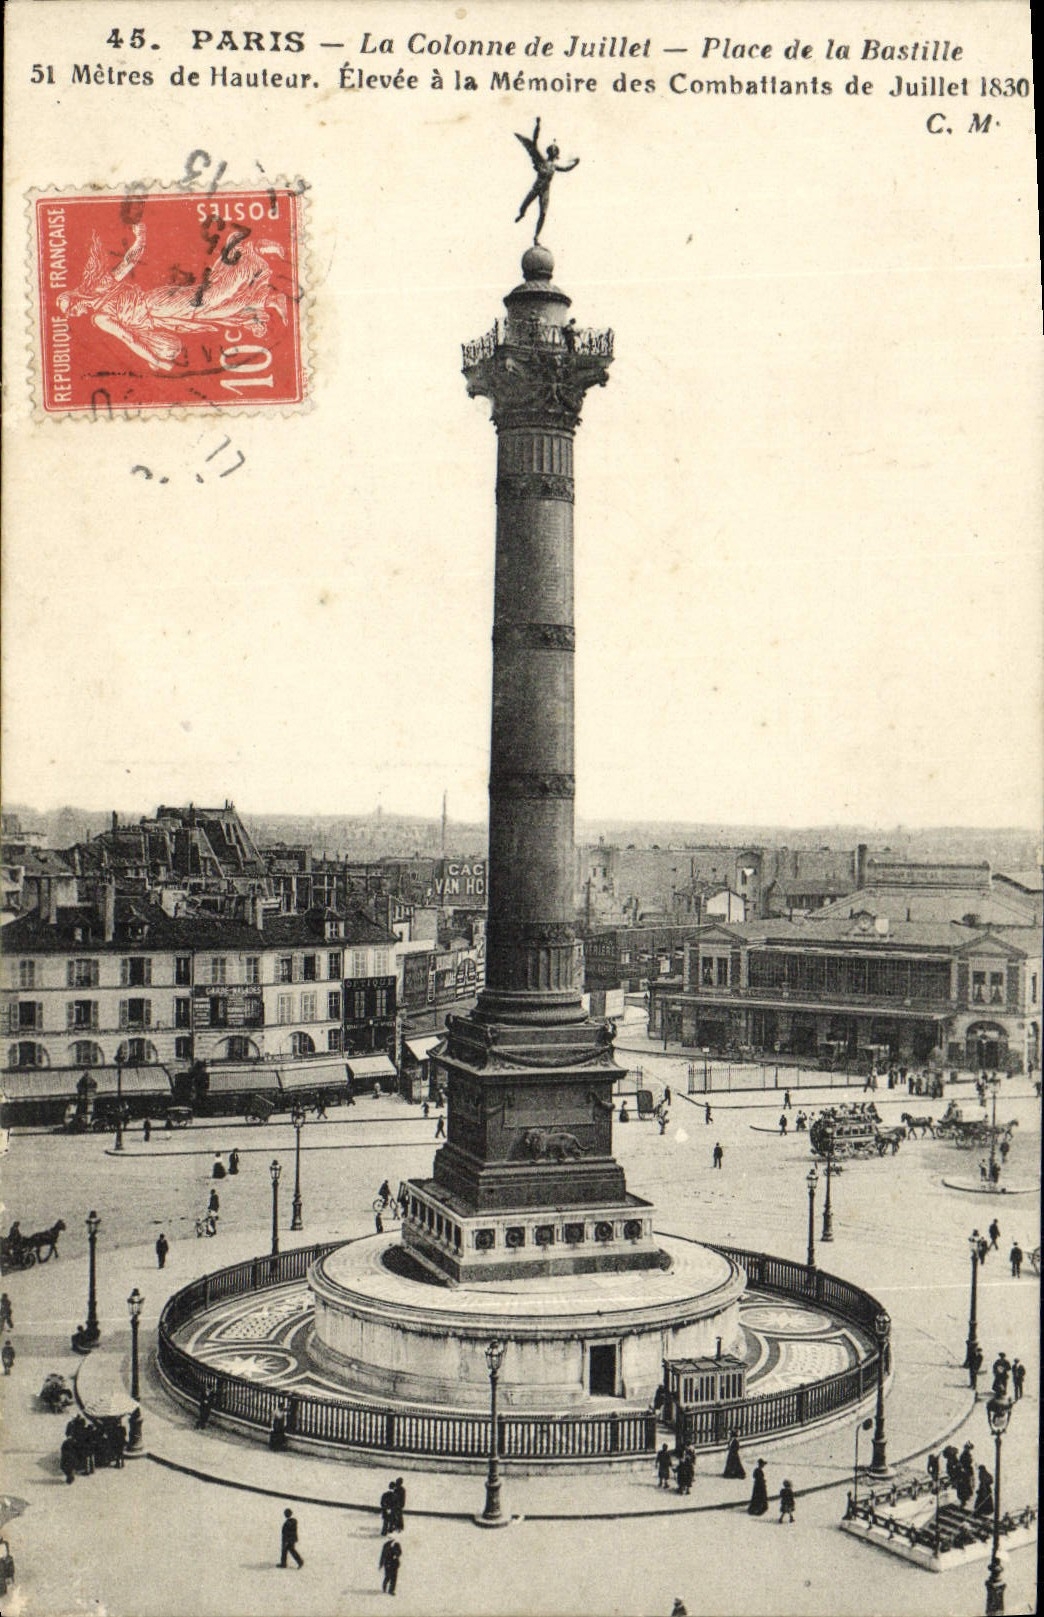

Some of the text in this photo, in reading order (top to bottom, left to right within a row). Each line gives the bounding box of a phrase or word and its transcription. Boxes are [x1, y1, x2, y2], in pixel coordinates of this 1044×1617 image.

[197, 203, 280, 222] POSTES
[47, 207, 69, 289] FRANÇAISE
[435, 878, 460, 895] VAN
